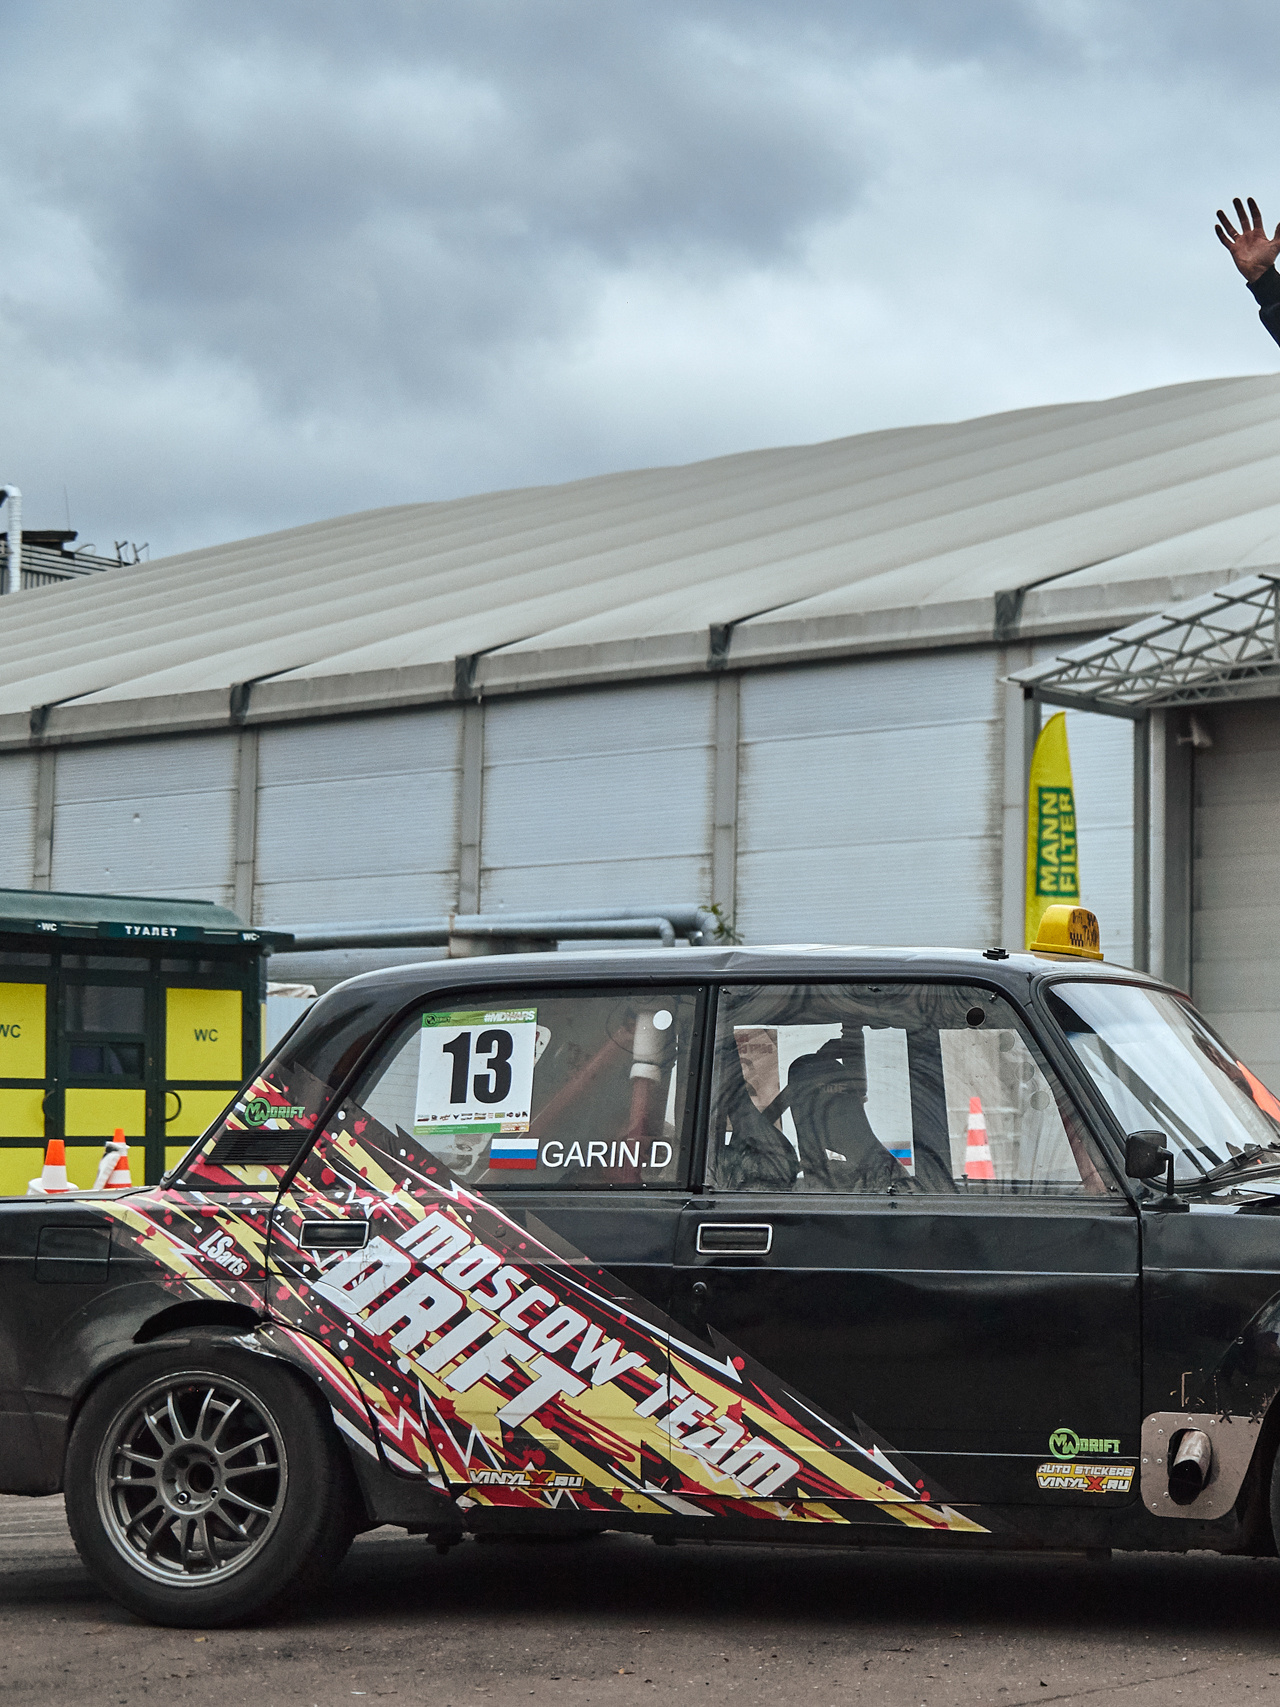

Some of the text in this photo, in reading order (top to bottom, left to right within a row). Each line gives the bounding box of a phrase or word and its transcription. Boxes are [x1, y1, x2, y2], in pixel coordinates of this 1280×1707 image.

[1039, 792, 1059, 892] MANN
[1059, 793, 1077, 892] FILTER
[41, 922, 57, 932] WC
[124, 925, 178, 937] ТУАЛЕТ
[242, 932, 258, 941] WC
[483, 1010, 535, 1023] #MDWARS
[194, 1029, 219, 1042] WC
[442, 1029, 514, 1104] 13
[270, 1105, 305, 1119] DRIFT
[541, 1140, 673, 1168] GARIN.D
[198, 1229, 248, 1276] LSarts
[310, 1235, 589, 1429] DRIFT
[396, 1210, 801, 1497] MOSCOW TEAM
[1079, 1438, 1121, 1454] DRIFT
[1038, 1464, 1133, 1477] AUTO STICKERS
[469, 1470, 583, 1488] VINYLX.RU
[1038, 1476, 1130, 1491] VINYLX.RU
